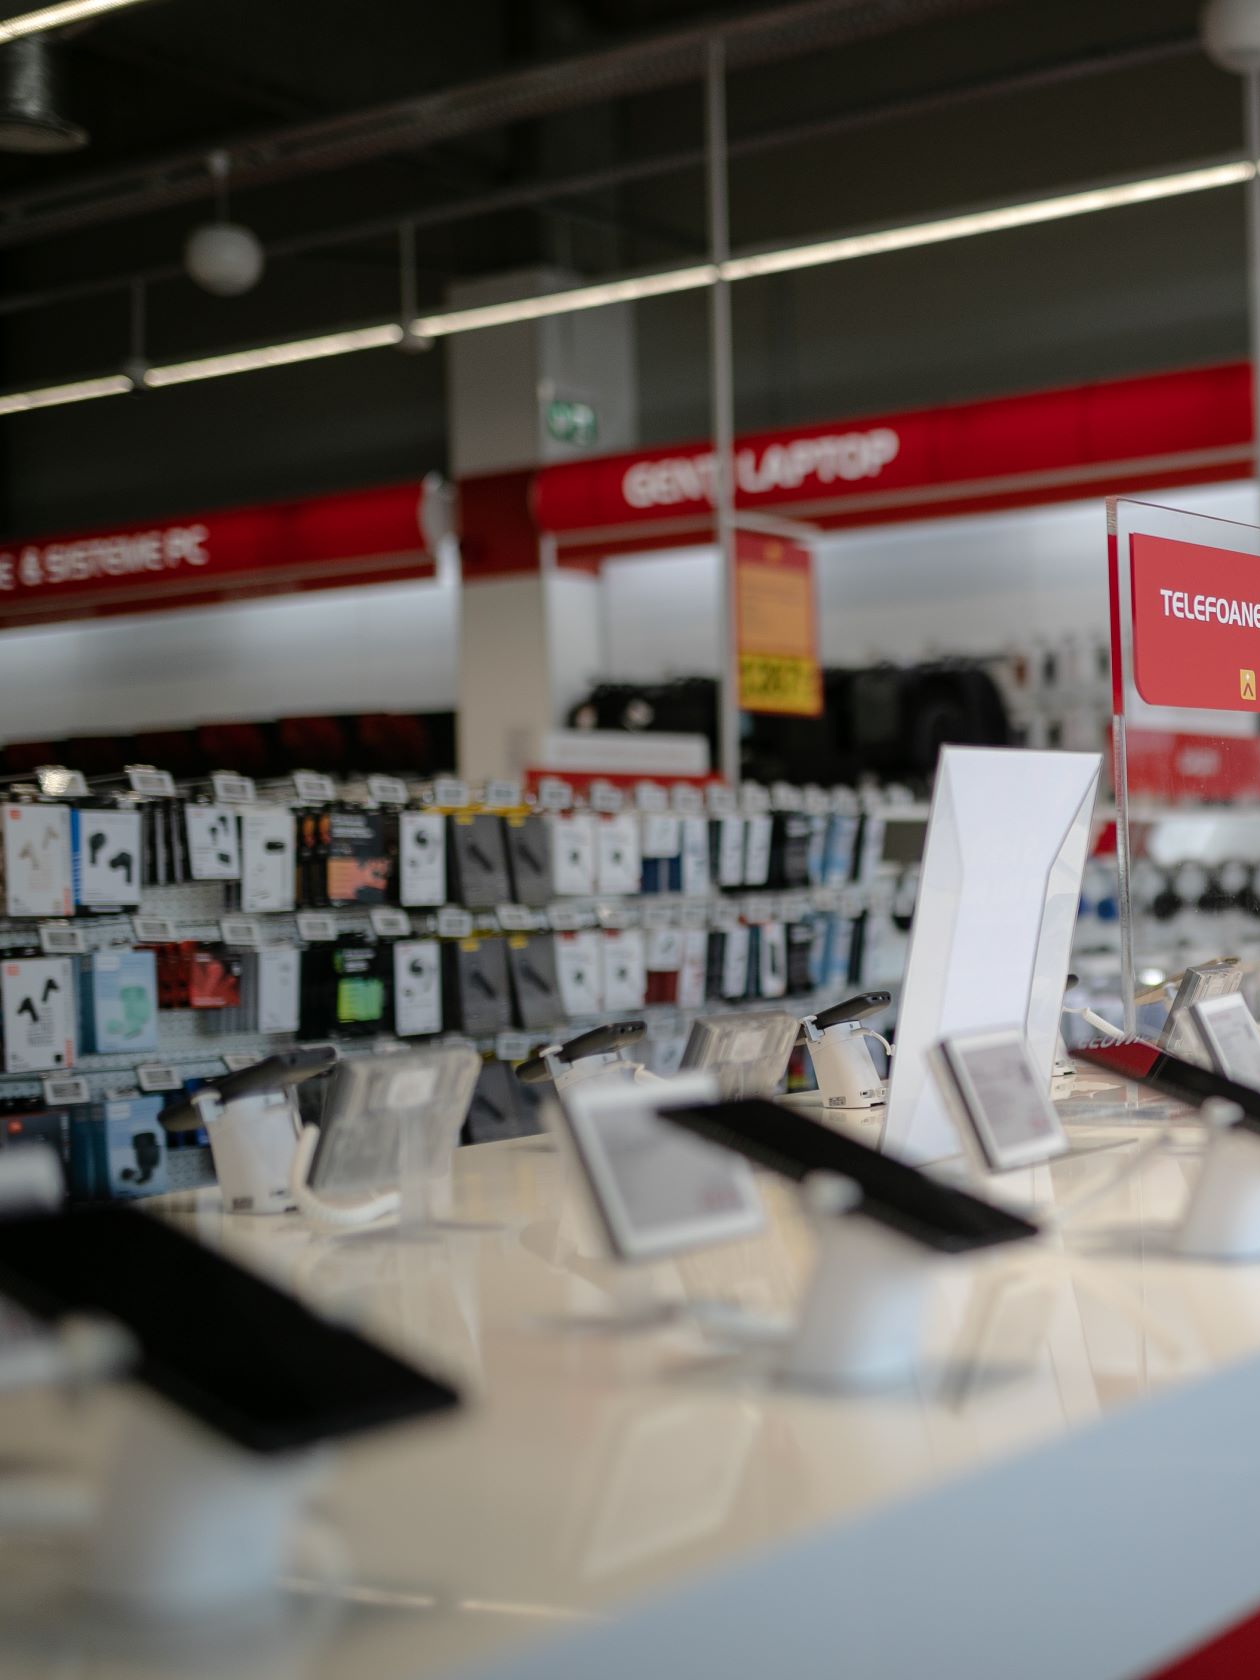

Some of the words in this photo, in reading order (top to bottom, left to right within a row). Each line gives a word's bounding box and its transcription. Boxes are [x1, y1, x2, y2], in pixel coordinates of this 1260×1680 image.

[737, 428, 899, 493] LAPTOP
[45, 530, 164, 583] SISTEME
[163, 523, 210, 568] PC
